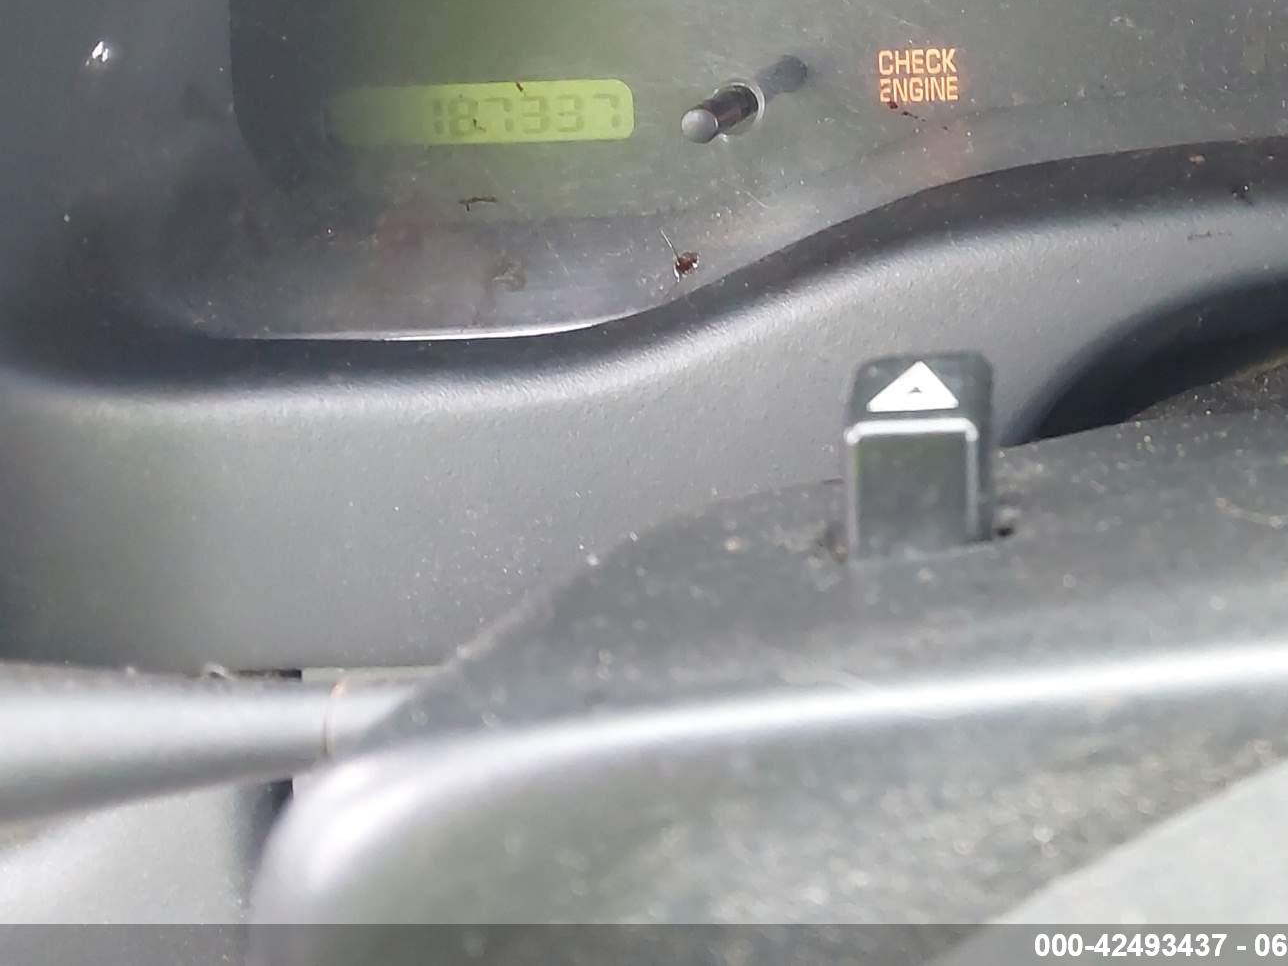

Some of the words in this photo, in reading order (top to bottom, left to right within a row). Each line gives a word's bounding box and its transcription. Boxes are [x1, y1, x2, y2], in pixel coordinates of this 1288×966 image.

[878, 48, 957, 76] CHECK
[879, 76, 959, 103] ENGINE
[432, 93, 622, 137] 187337
